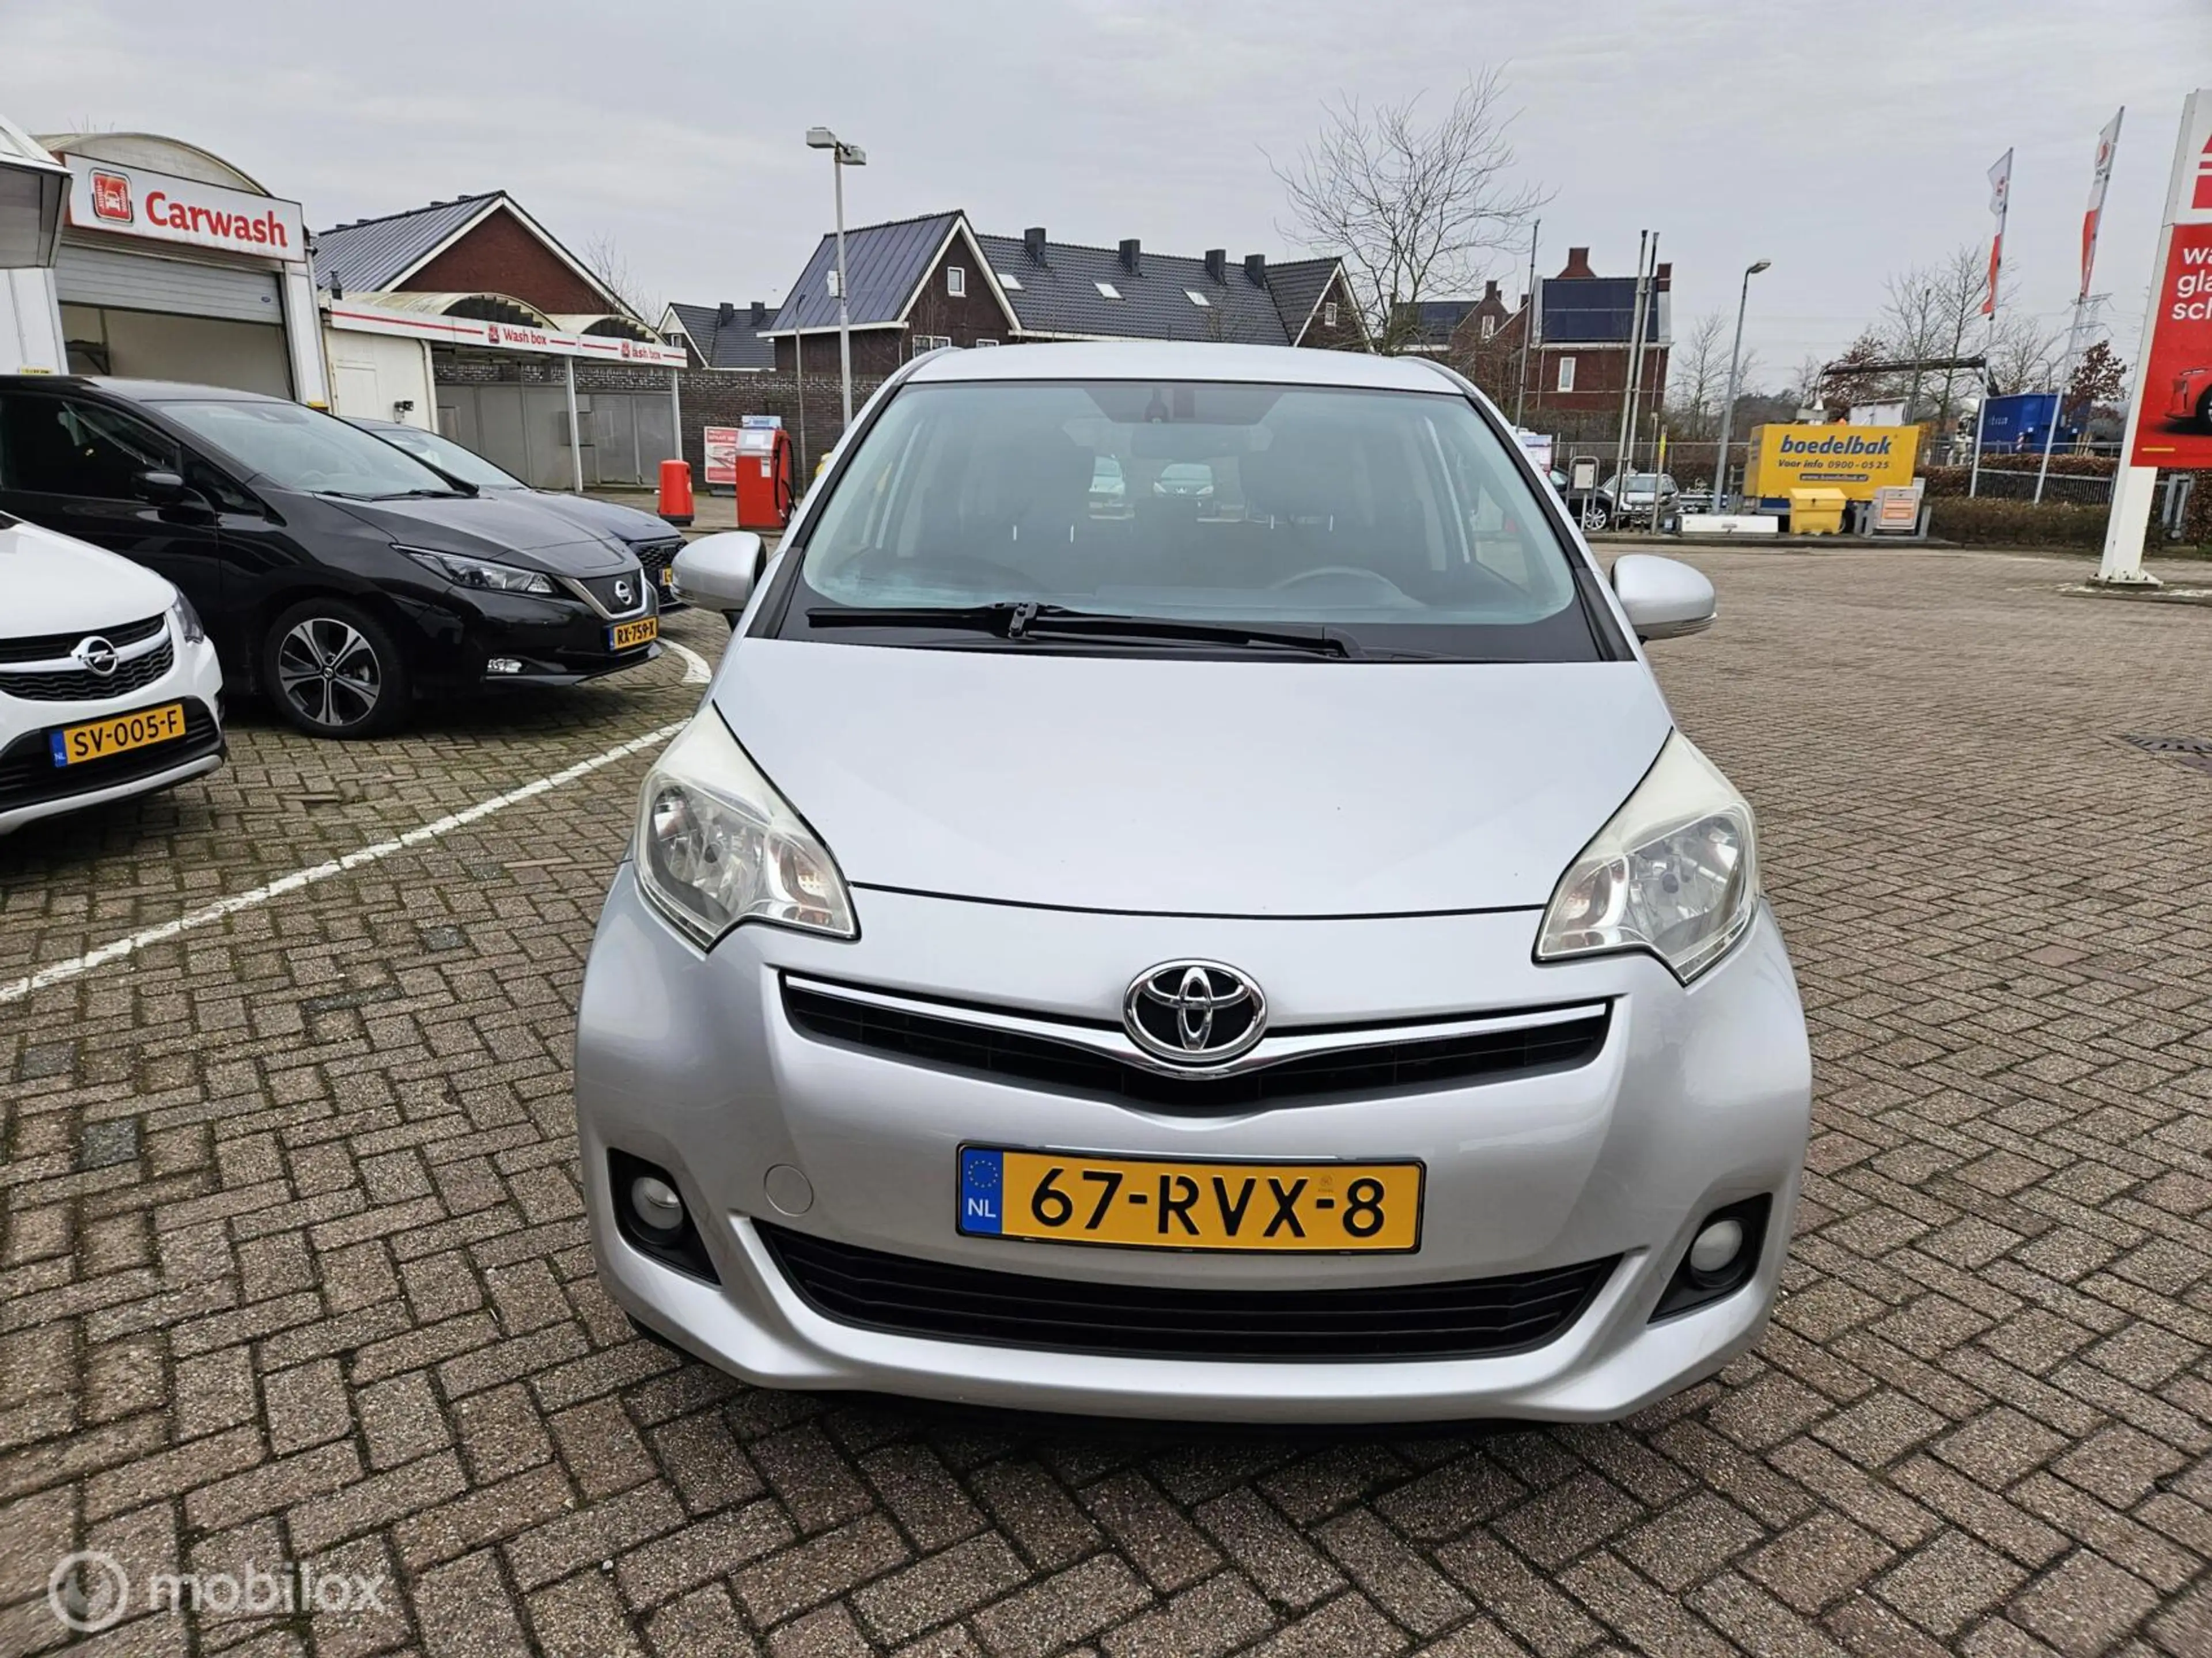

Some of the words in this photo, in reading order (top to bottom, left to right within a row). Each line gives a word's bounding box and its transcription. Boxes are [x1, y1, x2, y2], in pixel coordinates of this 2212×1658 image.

[146, 191, 288, 248] Carwash
[503, 326, 529, 343] Wash
[530, 329, 547, 346] box
[632, 346, 649, 358] ash
[1780, 434, 1892, 454] boedelbak
[1778, 459, 1801, 468] Voor
[1803, 459, 1823, 469] info
[74, 710, 177, 757] SV-005-F
[968, 1197, 997, 1218] NL
[1030, 1167, 1385, 1238] 67-RVX-8
